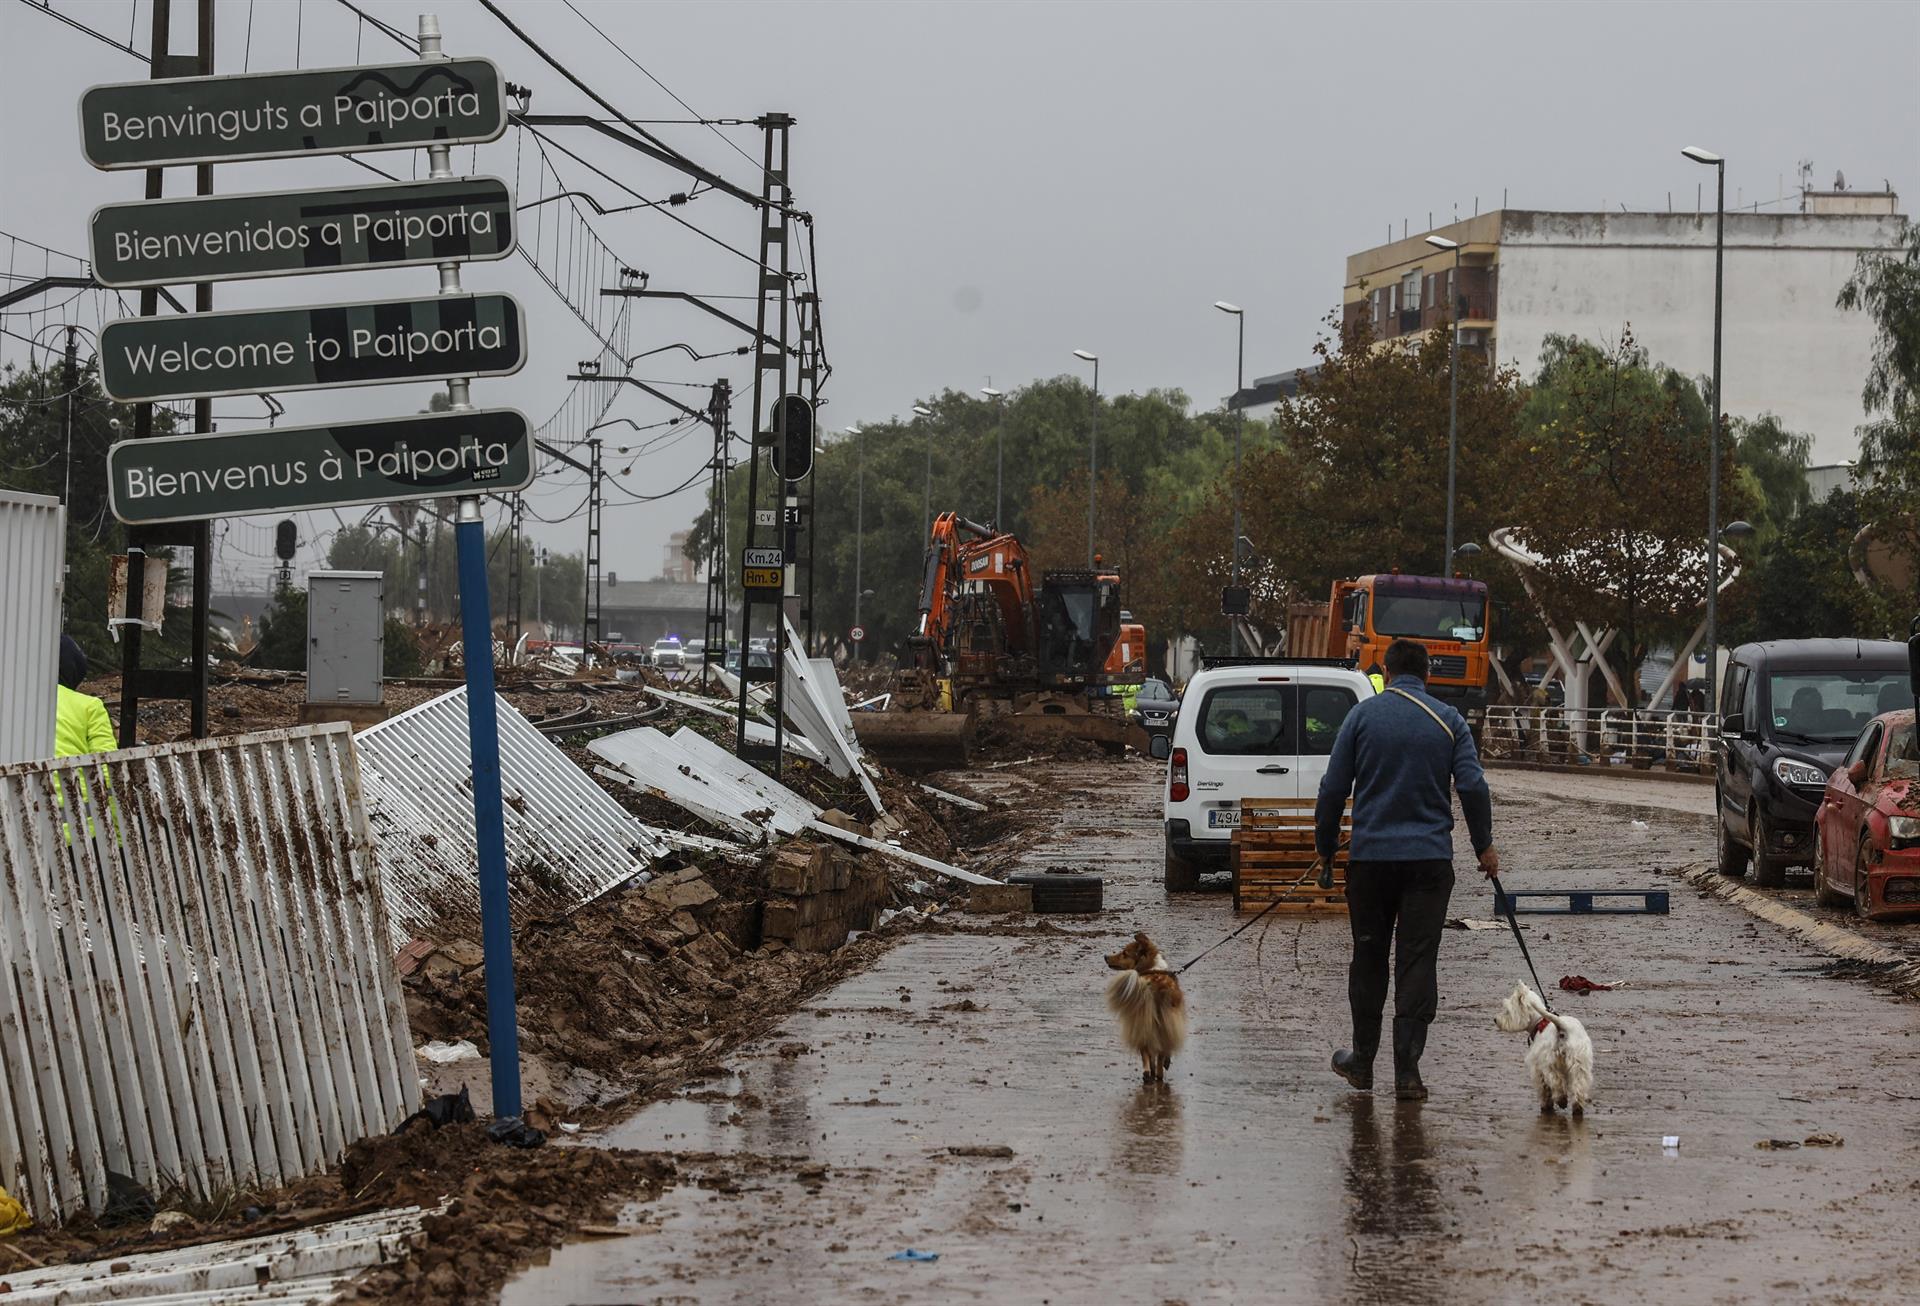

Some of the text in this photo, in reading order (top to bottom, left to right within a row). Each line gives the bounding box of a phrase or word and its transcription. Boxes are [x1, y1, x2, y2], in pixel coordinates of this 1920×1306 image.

[102, 88, 480, 142] Benvinguts a Paiporta
[115, 204, 492, 262] Bienvenidos a Paiporta
[124, 320, 501, 375] Welcome to Paiporta
[127, 438, 509, 499] Bienvenus à Paiporta
[746, 552, 781, 565] Km.24
[746, 571, 779, 584] Hm. 9
